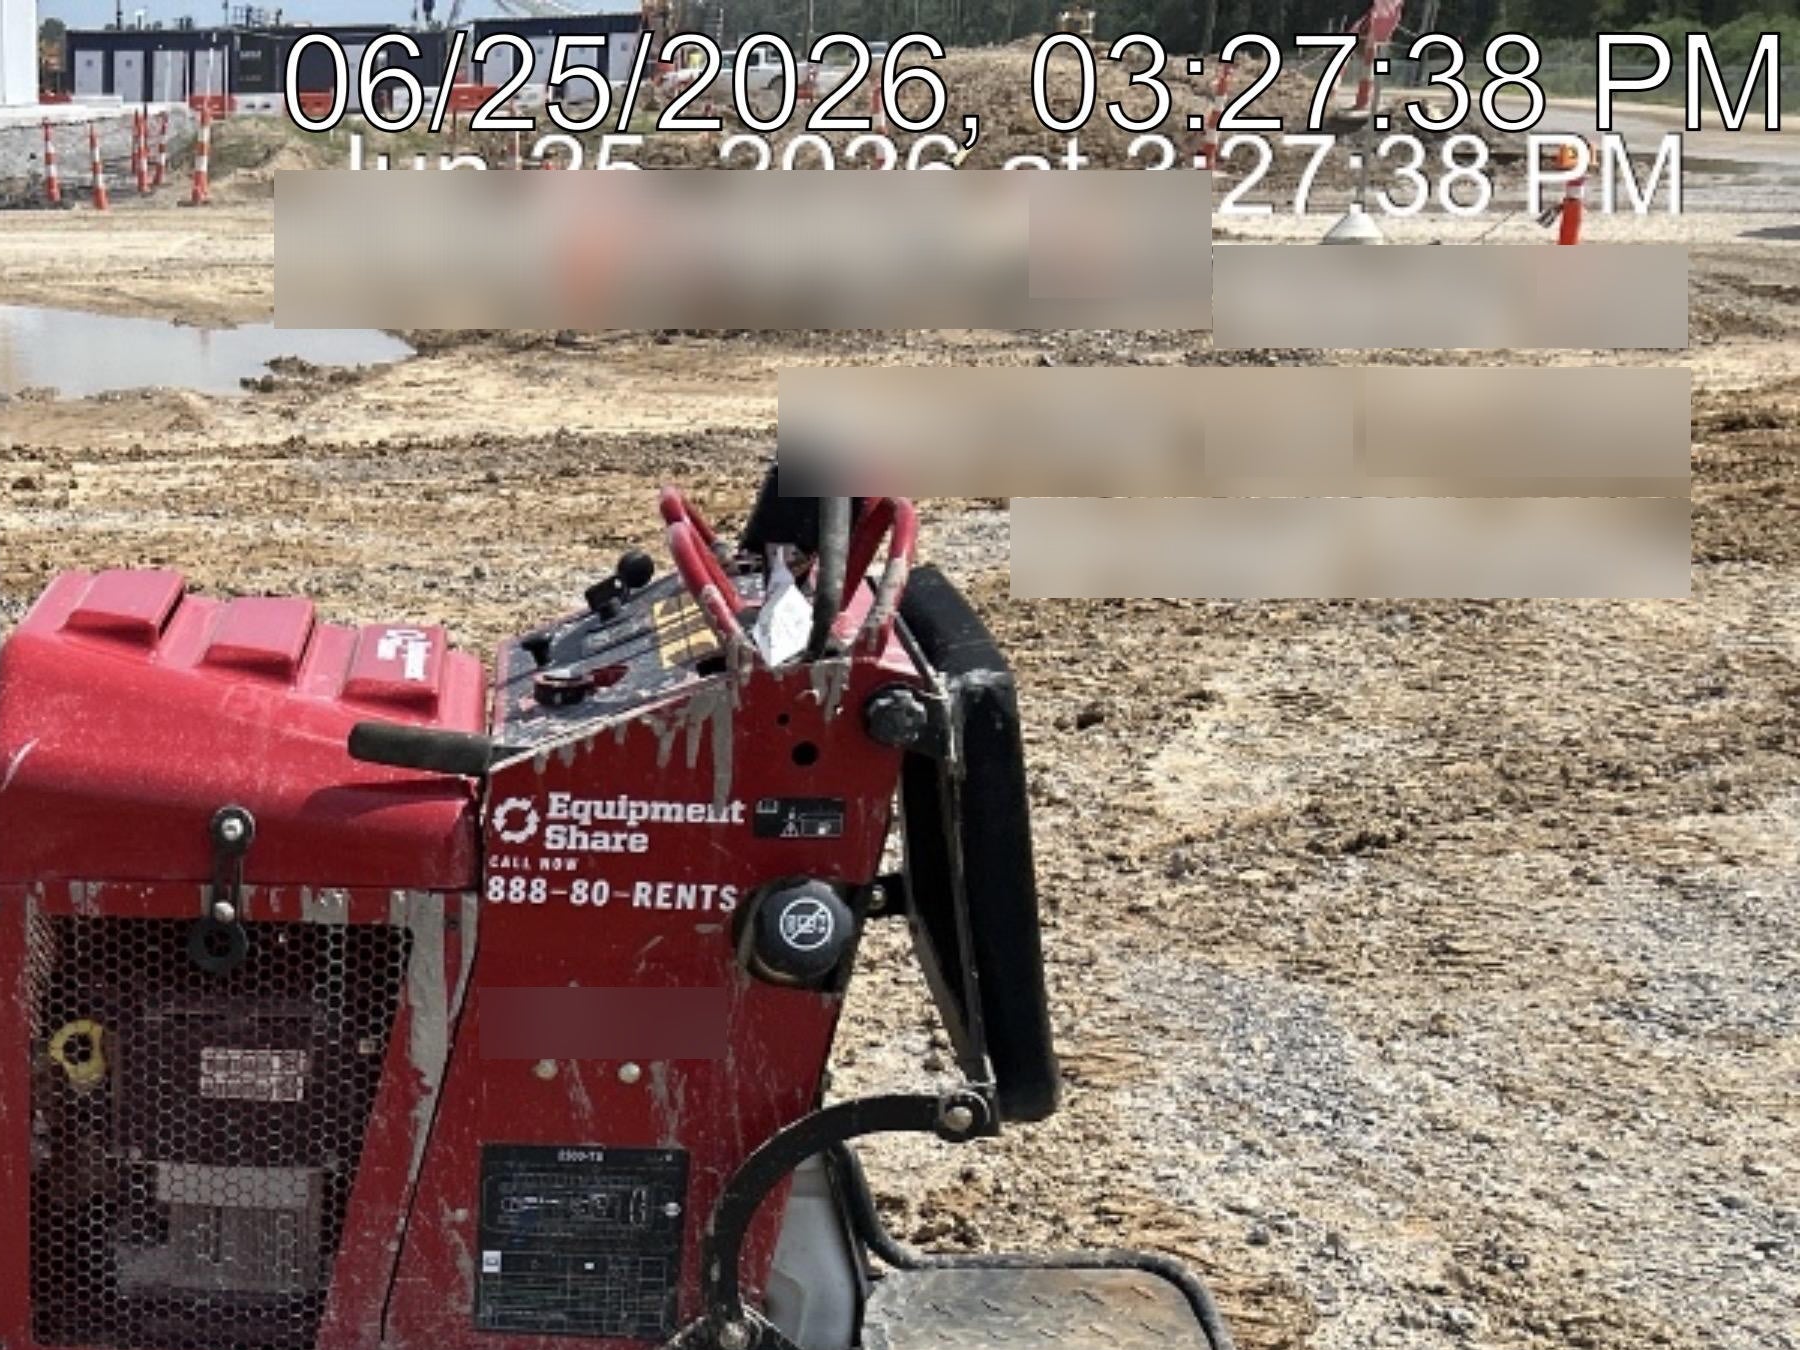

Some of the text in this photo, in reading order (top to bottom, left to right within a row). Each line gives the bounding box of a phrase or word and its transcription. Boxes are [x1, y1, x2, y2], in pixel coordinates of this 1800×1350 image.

[544, 824, 649, 852] Share
[488, 855, 579, 871] CALL NOW
[487, 876, 737, 912] 888-80-RENTS
